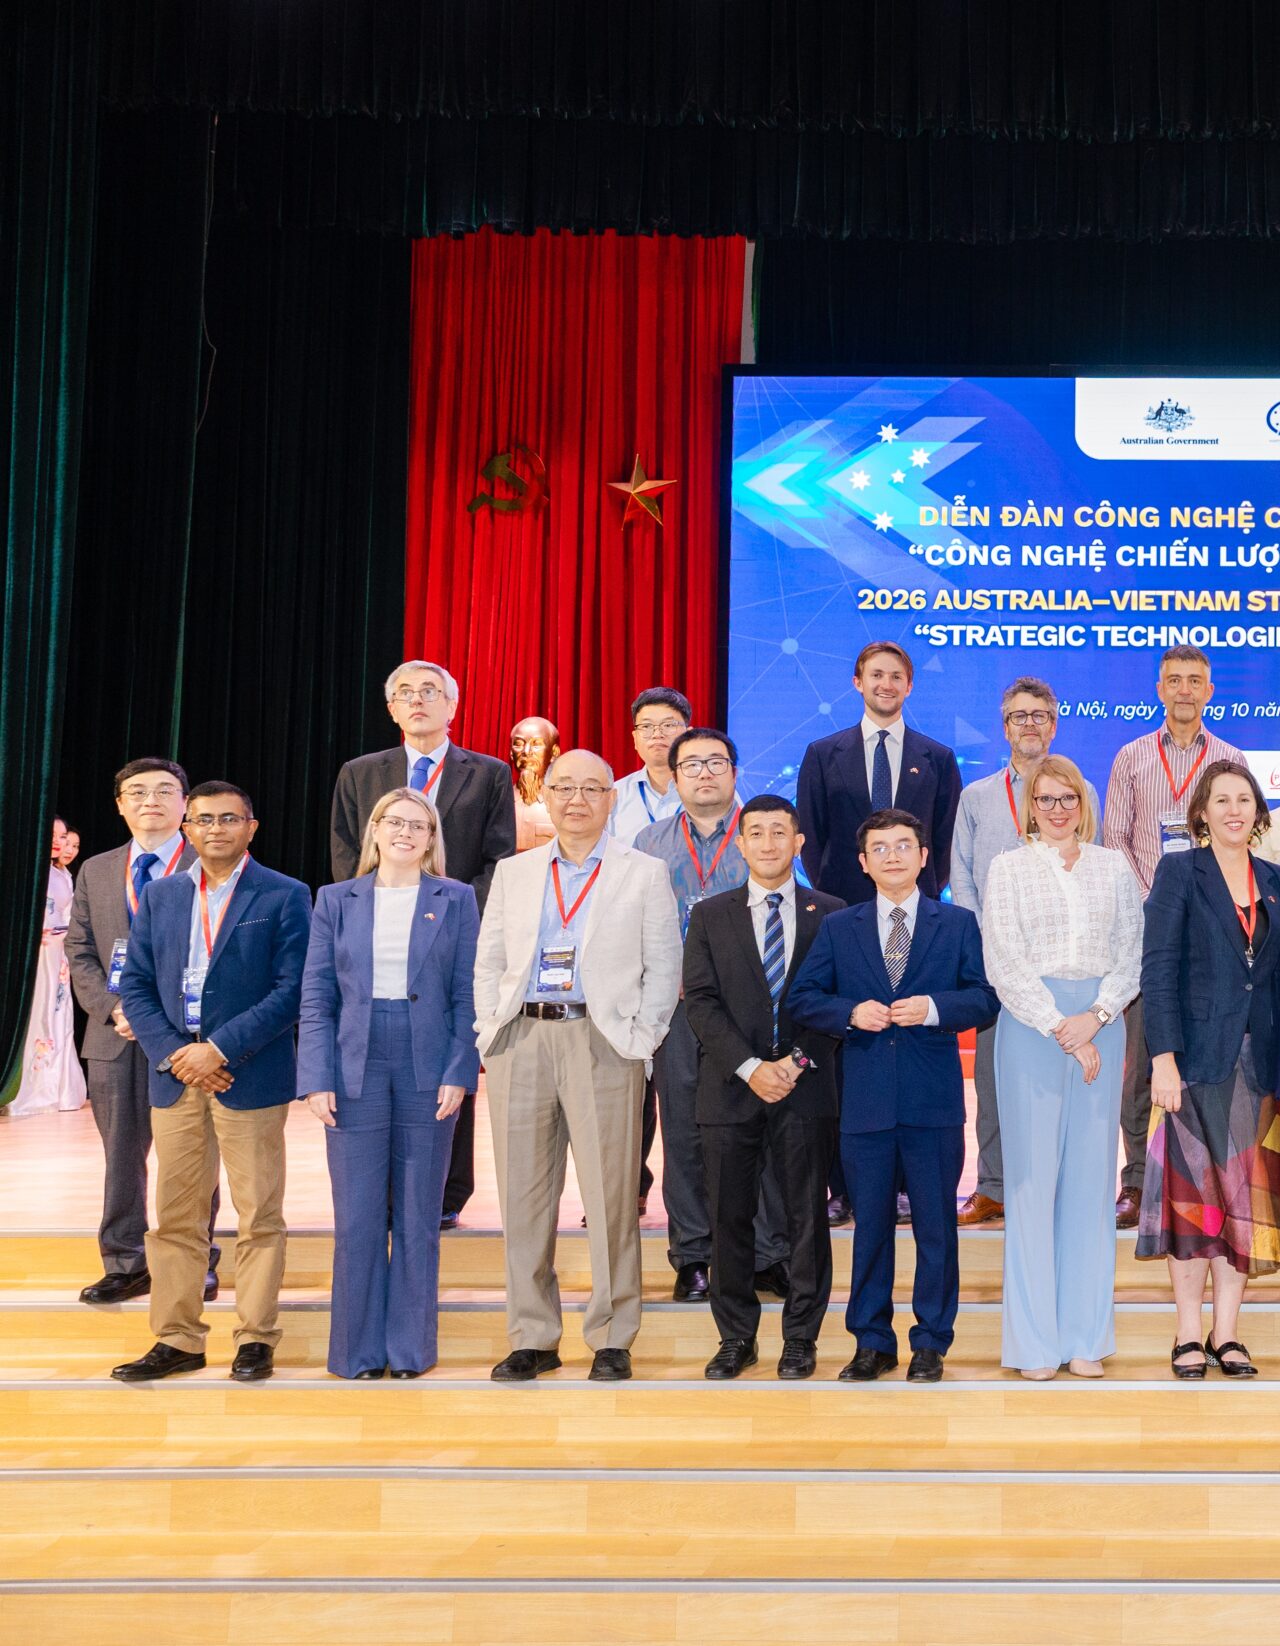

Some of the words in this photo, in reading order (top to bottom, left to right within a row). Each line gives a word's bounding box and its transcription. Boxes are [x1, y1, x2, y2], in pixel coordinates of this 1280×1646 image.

[1120, 436, 1164, 445] Australian
[1166, 436, 1219, 445] Government
[919, 495, 990, 527] DIỄN
[1000, 499, 1064, 527] ĐÀN
[1074, 500, 1160, 528] CÔNG
[1170, 500, 1256, 534] NGHỆ
[1021, 540, 1107, 573] NGHỆ
[1116, 538, 1209, 567] CHIẾN
[857, 588, 927, 611] 2026
[1076, 700, 1108, 720] Nội,
[1114, 702, 1157, 720] ngày
[1231, 703, 1249, 717] 10
